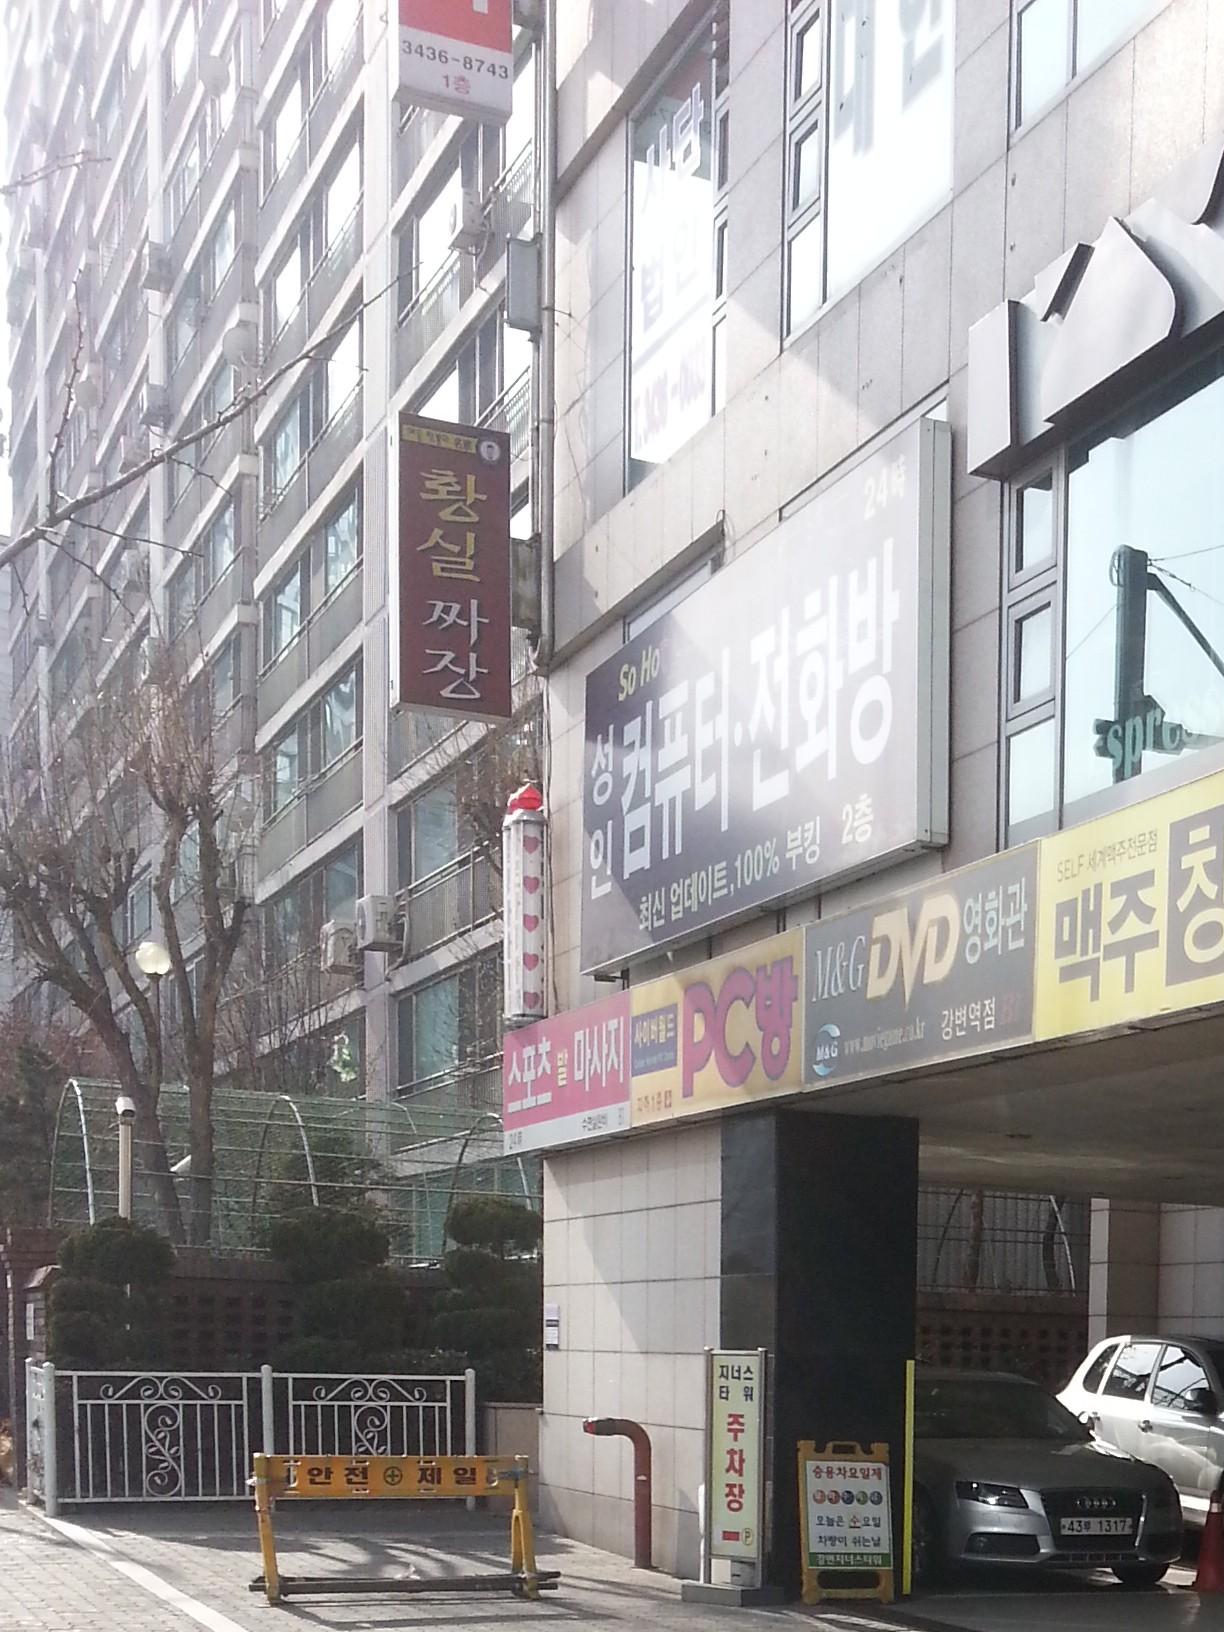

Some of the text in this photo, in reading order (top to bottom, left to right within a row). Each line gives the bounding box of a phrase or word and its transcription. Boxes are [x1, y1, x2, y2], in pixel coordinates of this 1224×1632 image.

[402, 40, 509, 79] 3436-8743
[443, 74, 471, 95] 1층
[416, 468, 488, 583] 황실
[422, 598, 489, 700] 짜장
[588, 732, 614, 900] 성인
[638, 890, 666, 932] 최신
[784, 828, 823, 872] 부킹
[841, 794, 875, 845] 2층
[1057, 854, 1085, 884] SELF
[869, 895, 961, 1005] DVD
[963, 877, 1029, 966] 영화관
[507, 1035, 554, 1113] 스포츠
[573, 1014, 625, 1093] 마사지
[681, 954, 800, 1099] PC방
[940, 996, 997, 1042] 강변역점
[718, 1364, 754, 1381] 지너스
[724, 1413, 746, 1512] 주차장
[1097, 1519, 1127, 1533] 1317
